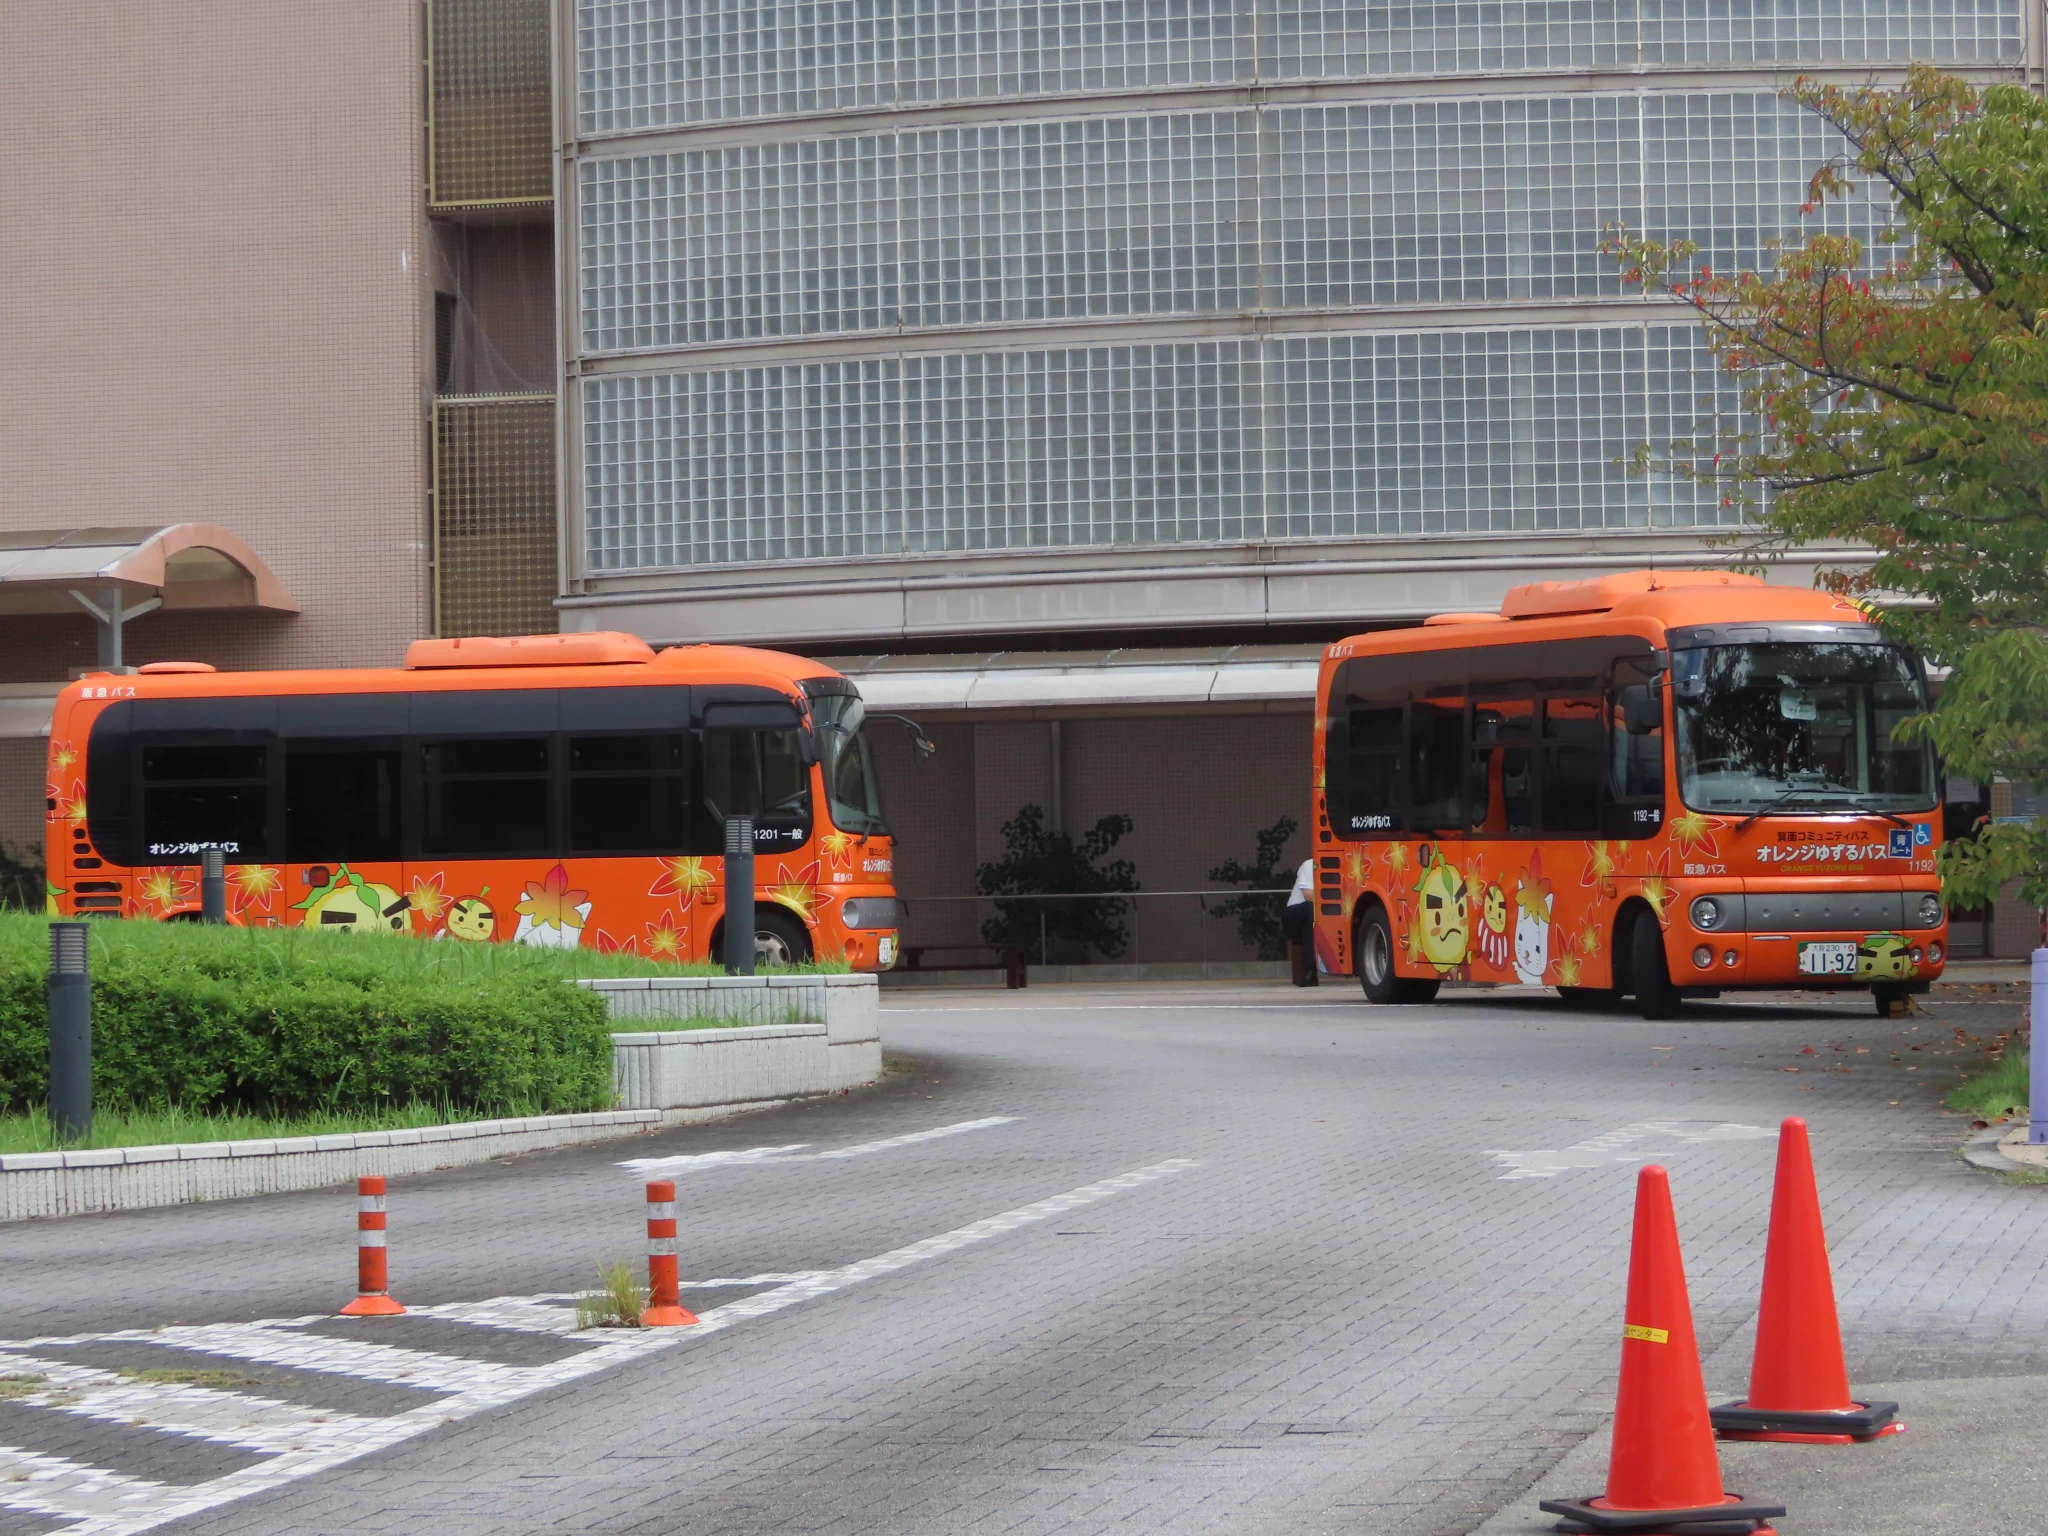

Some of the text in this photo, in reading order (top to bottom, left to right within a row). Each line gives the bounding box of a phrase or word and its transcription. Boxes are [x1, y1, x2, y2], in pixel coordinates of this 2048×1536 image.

[82, 687, 136, 698] 阪急バス
[1633, 810, 1647, 821] 1192
[1352, 815, 1391, 828] オレンジゆずるバス
[754, 829, 803, 839] 1201 一般
[1777, 831, 1869, 842] 箕面コミュニティバス
[1896, 834, 1907, 846] 青
[1756, 844, 1888, 861] オレンジゆずるバス
[1891, 846, 1911, 854] ルート
[1684, 864, 1726, 875] 阪急バス
[1781, 865, 1813, 873] ORANGE
[1909, 860, 1934, 872] 1192
[1811, 953, 1855, 972] 11-92
